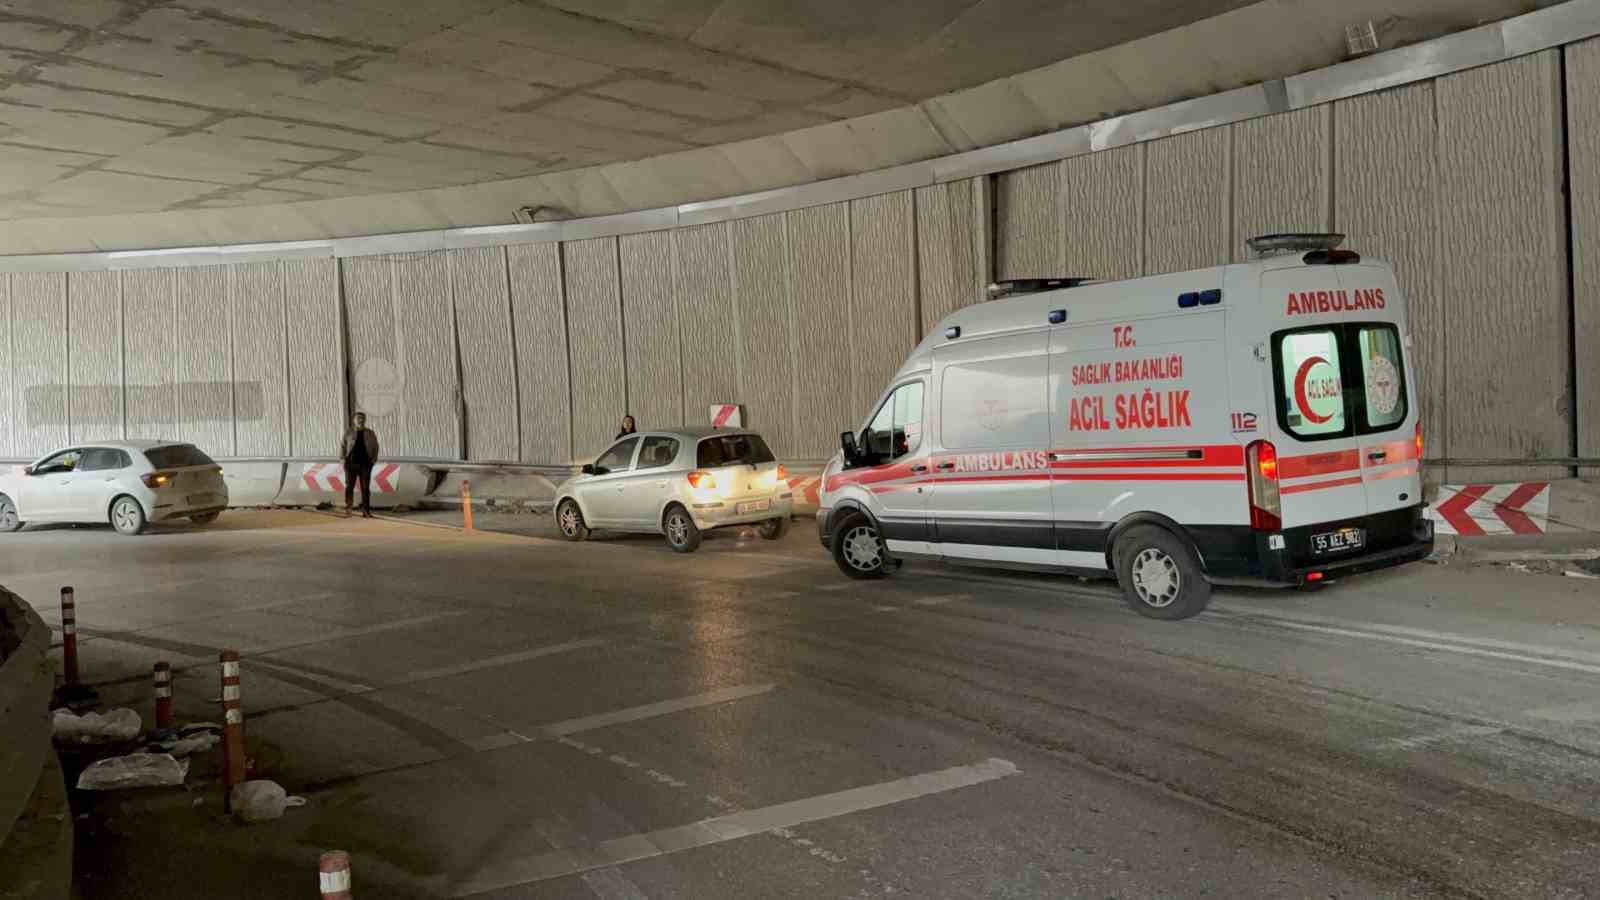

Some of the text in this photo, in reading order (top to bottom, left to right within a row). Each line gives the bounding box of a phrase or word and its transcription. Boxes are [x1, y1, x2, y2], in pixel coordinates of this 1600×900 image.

[1287, 288, 1386, 315] AMBULANS
[1114, 326, 1136, 347] T.C.
[1115, 388, 1191, 430] SAĞLIK
[1231, 413, 1257, 429] 112
[954, 452, 1048, 472] AMBULANS
